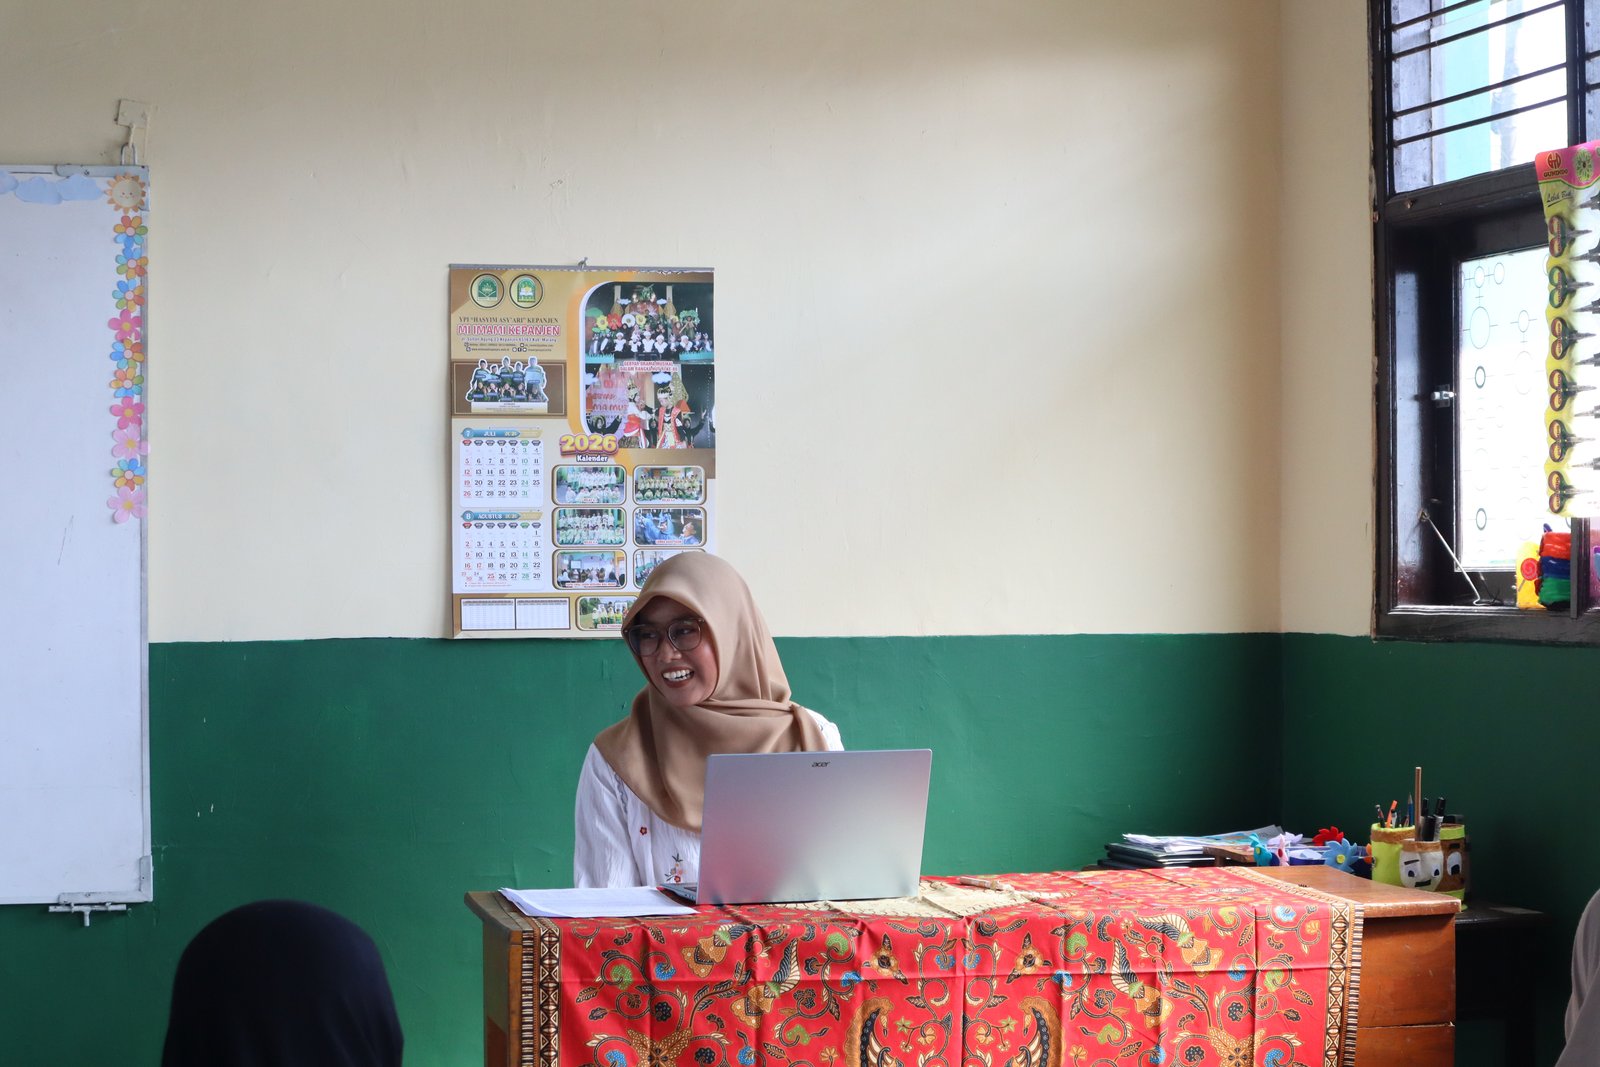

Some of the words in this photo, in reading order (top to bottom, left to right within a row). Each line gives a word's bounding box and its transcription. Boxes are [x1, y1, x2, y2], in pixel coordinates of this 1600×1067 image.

[458, 325, 471, 335] MI
[473, 325, 507, 335] IMAMI
[508, 326, 560, 335] KEPANJEN
[560, 435, 618, 452] 2026
